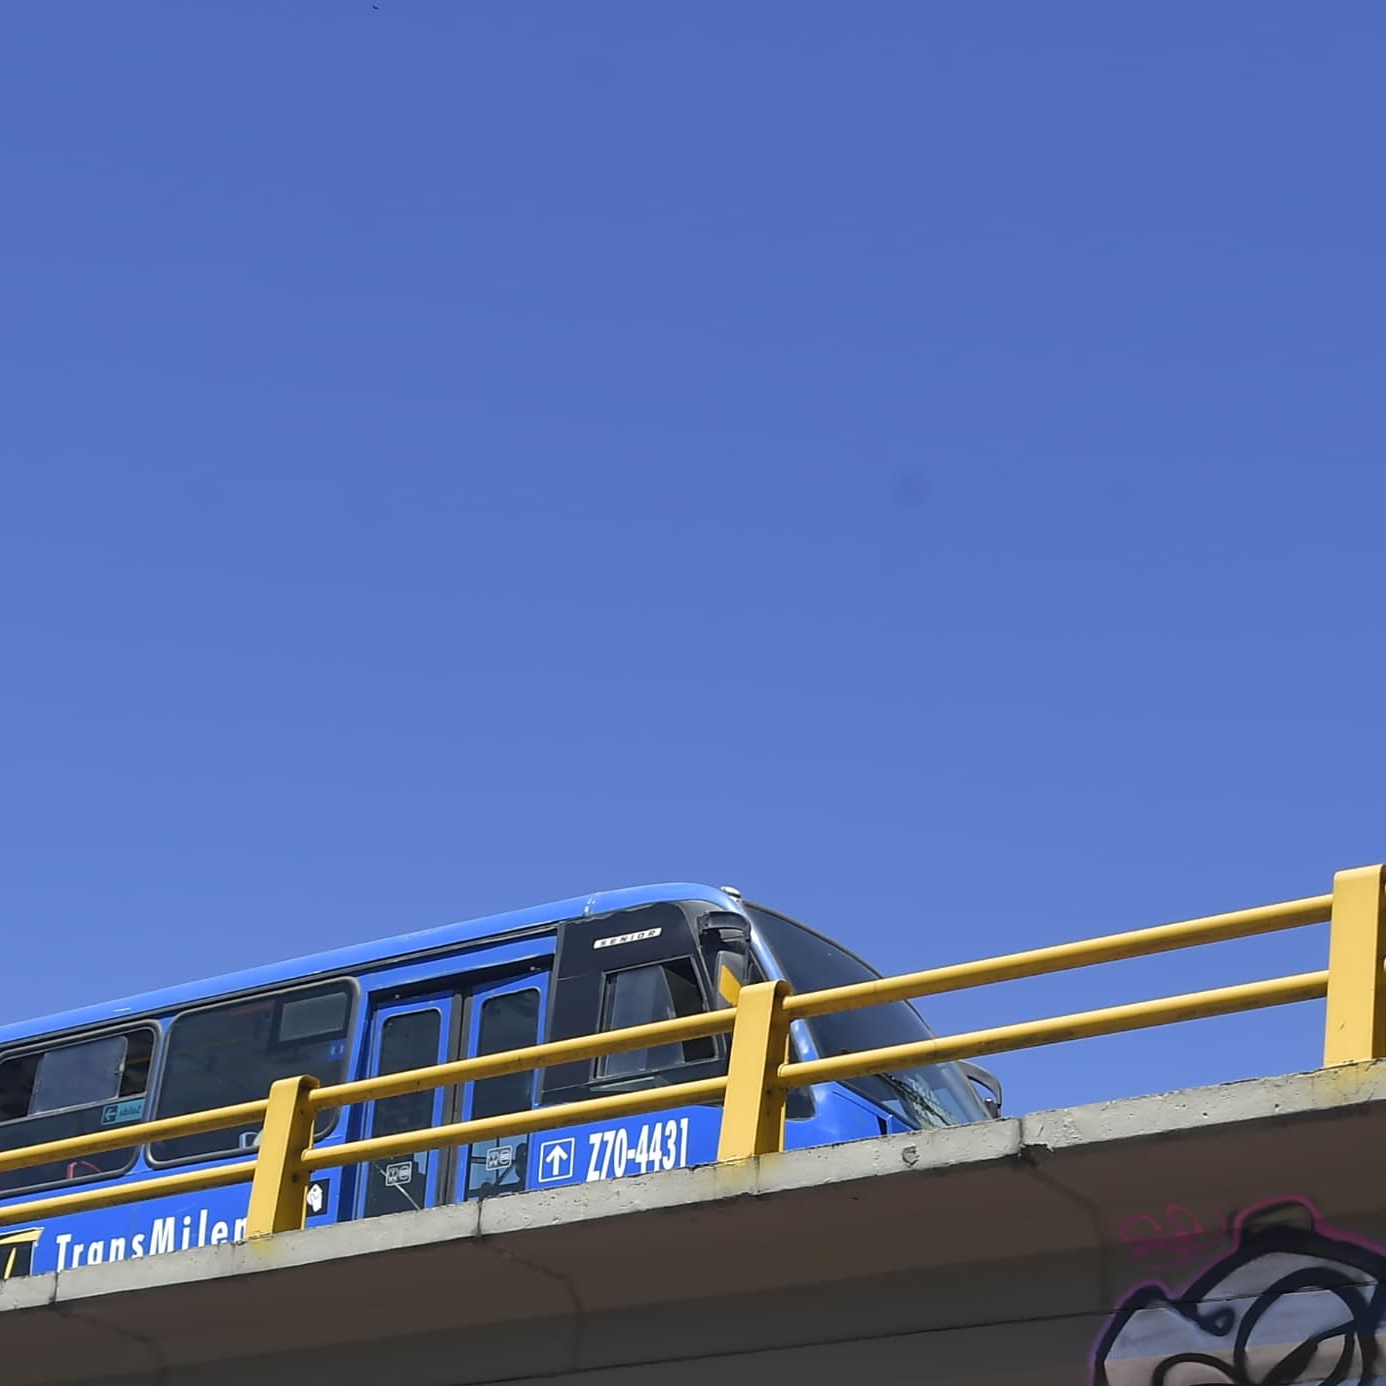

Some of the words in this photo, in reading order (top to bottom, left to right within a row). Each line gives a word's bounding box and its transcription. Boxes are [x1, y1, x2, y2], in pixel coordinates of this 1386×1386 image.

[600, 930, 656, 946] SENIOR
[586, 1117, 689, 1182] Z70-4431
[56, 1208, 249, 1273] TransMilen
